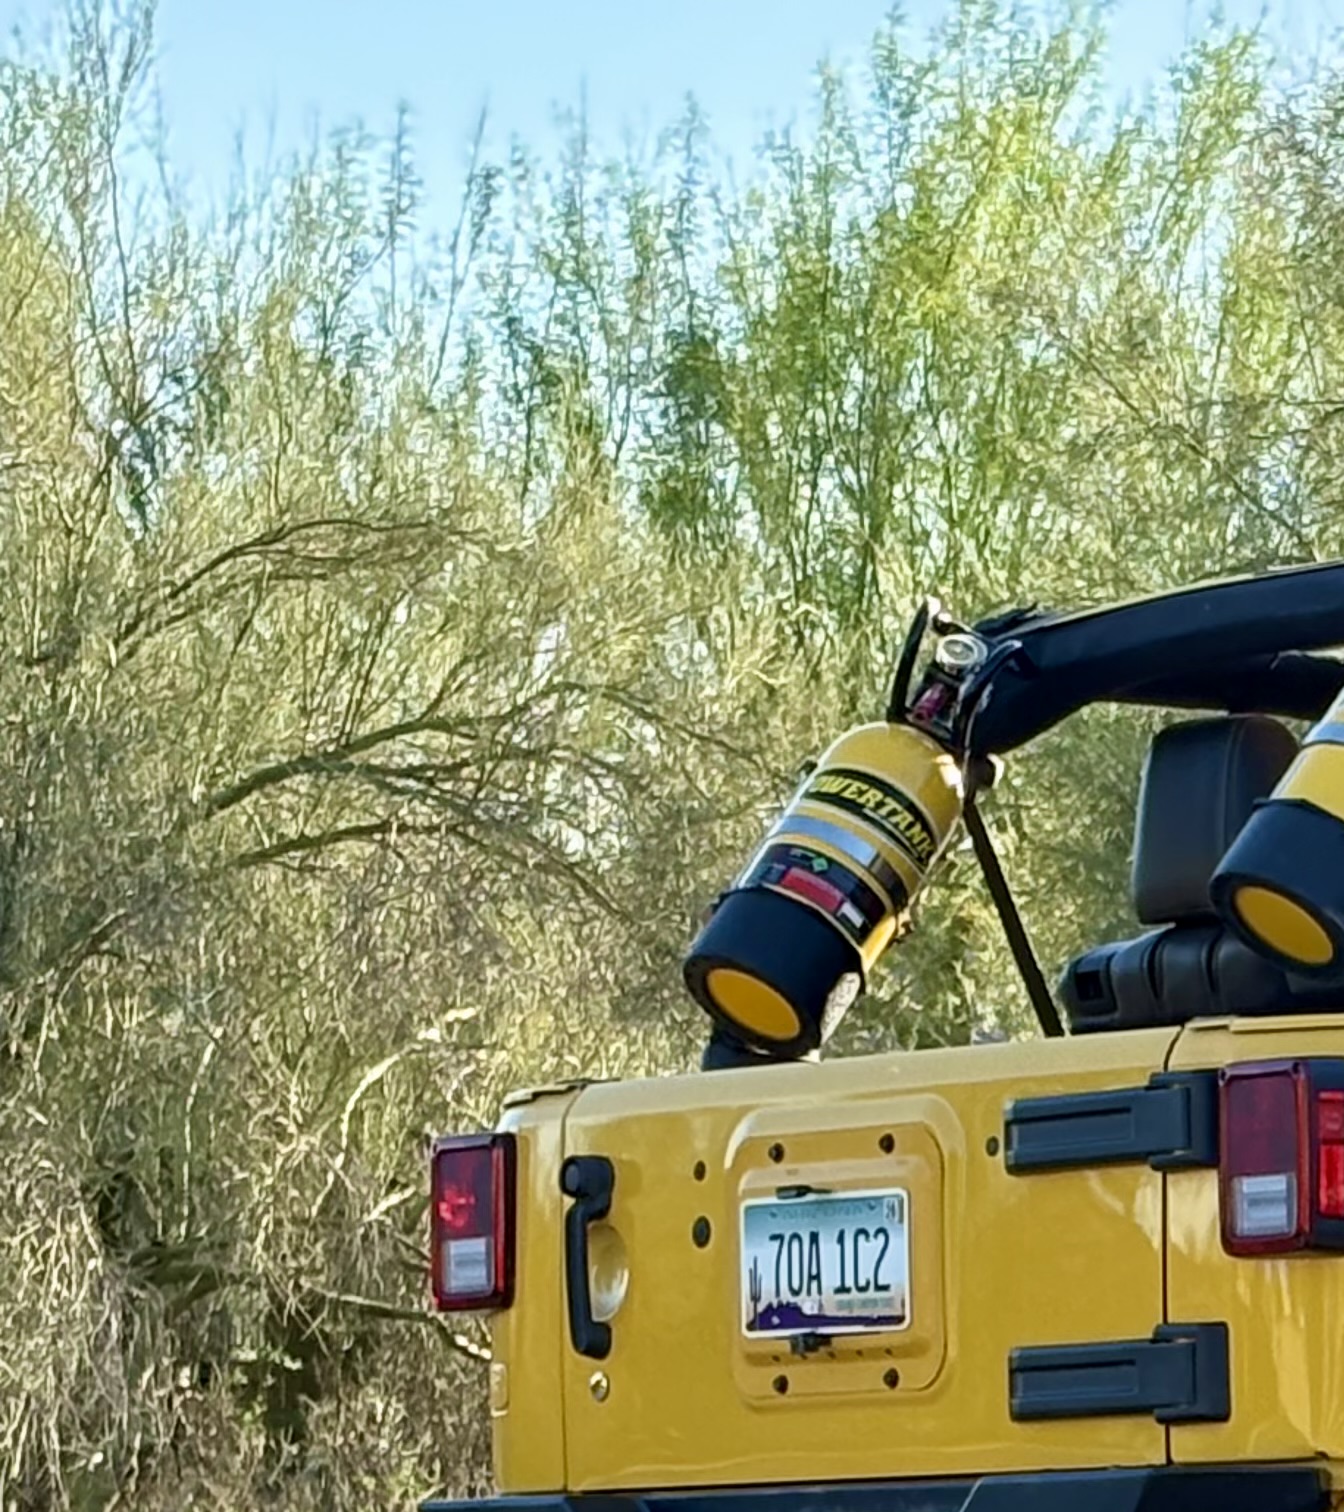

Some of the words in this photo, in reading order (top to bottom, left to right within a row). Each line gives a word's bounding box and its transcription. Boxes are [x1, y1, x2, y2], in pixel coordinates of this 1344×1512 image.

[809, 775, 935, 859] OWERTANK
[769, 1231, 823, 1298] 70A
[833, 1226, 891, 1294] 1C2
